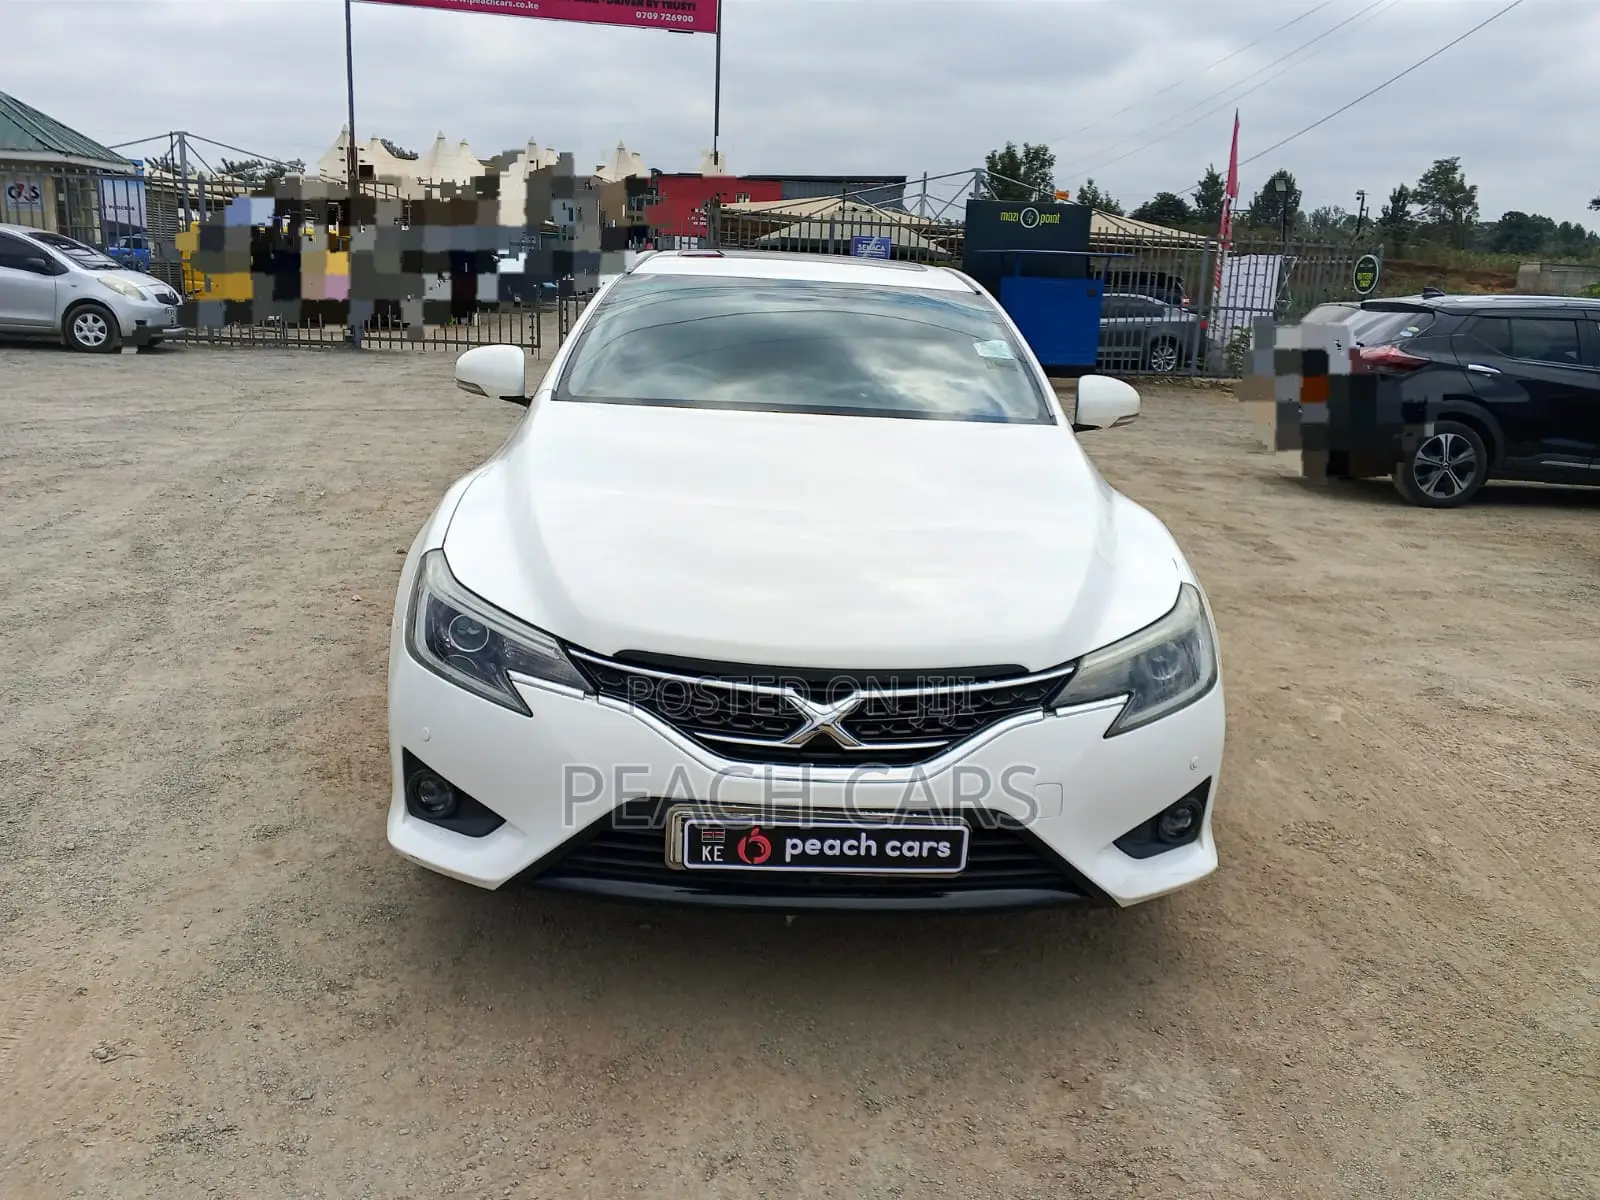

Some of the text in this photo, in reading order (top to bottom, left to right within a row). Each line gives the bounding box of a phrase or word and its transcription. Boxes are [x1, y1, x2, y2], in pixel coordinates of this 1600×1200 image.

[635, 11, 694, 22] 0709 726900
[1039, 212, 1061, 226] point
[702, 846, 724, 862] KE
[784, 832, 951, 862] peach cars
